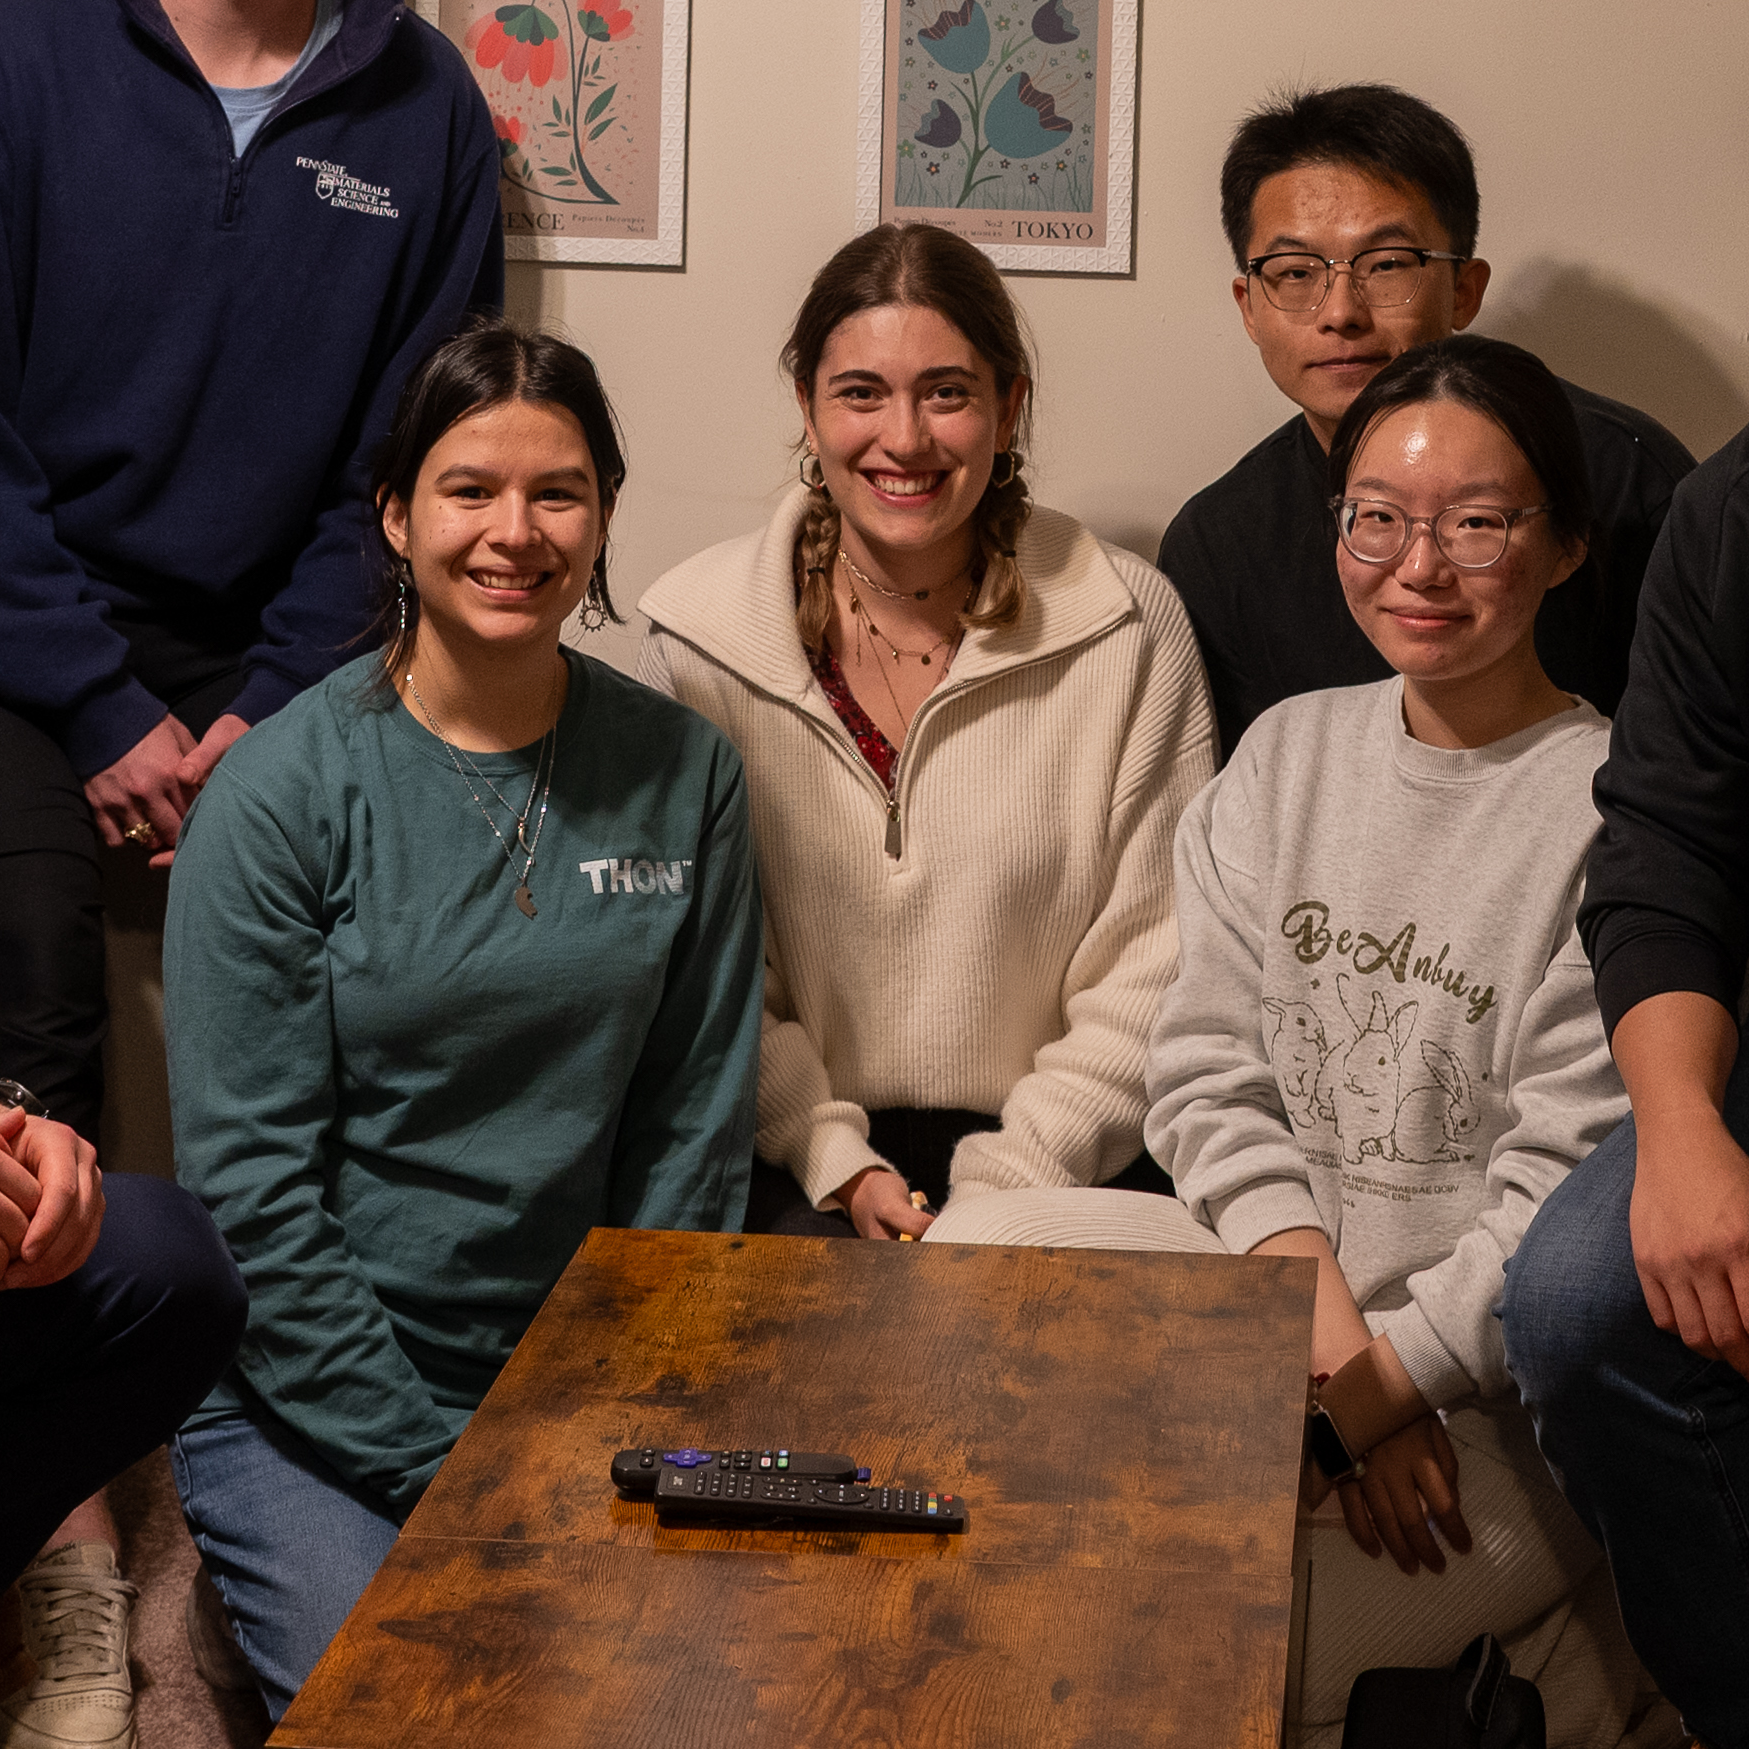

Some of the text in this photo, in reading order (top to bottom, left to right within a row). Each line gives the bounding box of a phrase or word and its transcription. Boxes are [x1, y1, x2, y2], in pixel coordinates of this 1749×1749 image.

[333, 176, 391, 198] MATERIALS
[336, 188, 379, 206] SCIENCE
[330, 196, 400, 219] ENGINEERING
[501, 211, 565, 231] ENCE
[1011, 220, 1094, 240] TOKYO
[579, 858, 684, 895] THON
